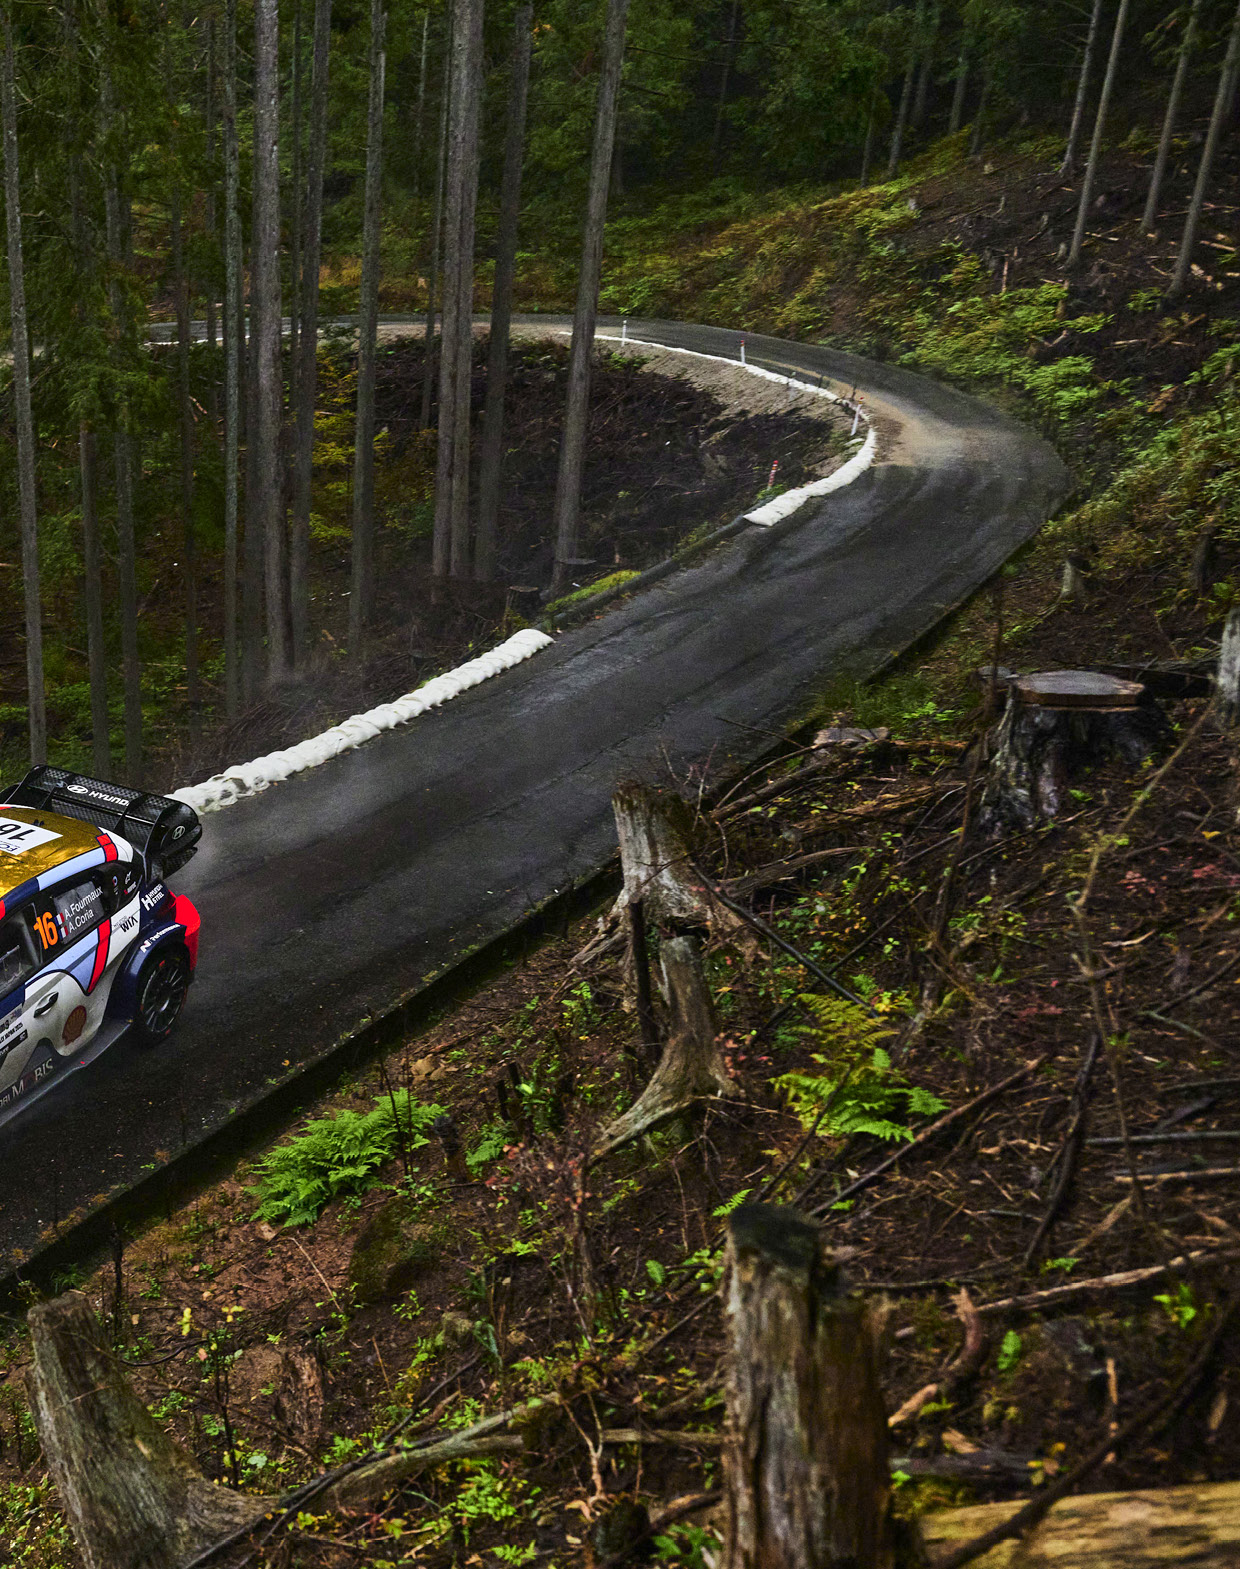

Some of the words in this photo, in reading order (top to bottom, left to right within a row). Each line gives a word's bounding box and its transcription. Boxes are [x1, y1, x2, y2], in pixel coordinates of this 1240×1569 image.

[88, 790, 130, 807] HYUND
[64, 886, 104, 920] A.Fourmaux
[152, 891, 165, 904] STEEL
[33, 911, 59, 950] 16
[68, 909, 95, 934] A.Coria
[120, 916, 139, 933] WIA
